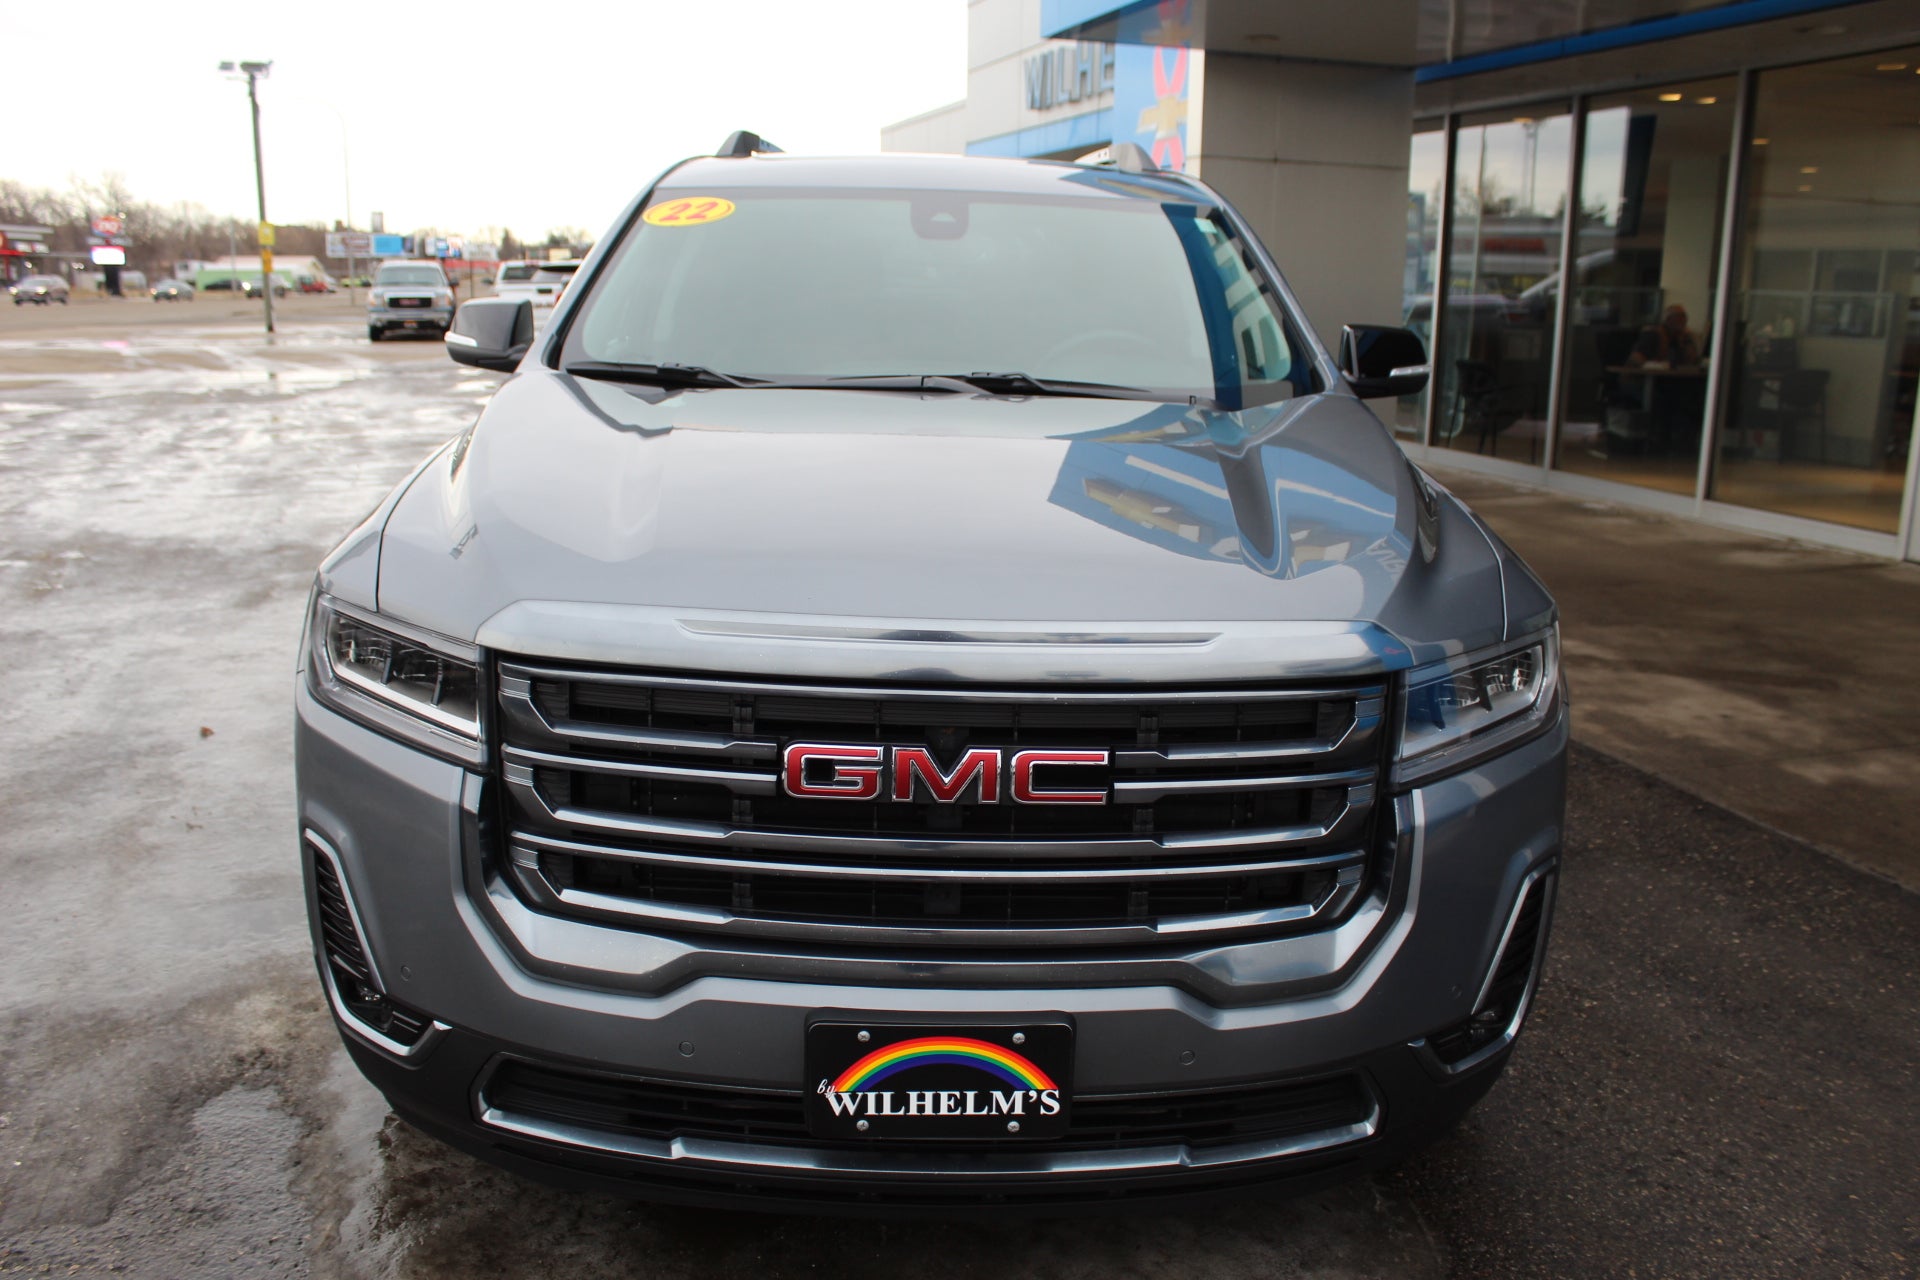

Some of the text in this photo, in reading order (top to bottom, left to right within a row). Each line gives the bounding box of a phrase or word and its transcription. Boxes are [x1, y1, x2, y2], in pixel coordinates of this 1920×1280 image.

[659, 201, 719, 222] 22
[782, 743, 1109, 805] GMC
[816, 1078, 1061, 1116] by WILHELM'S
